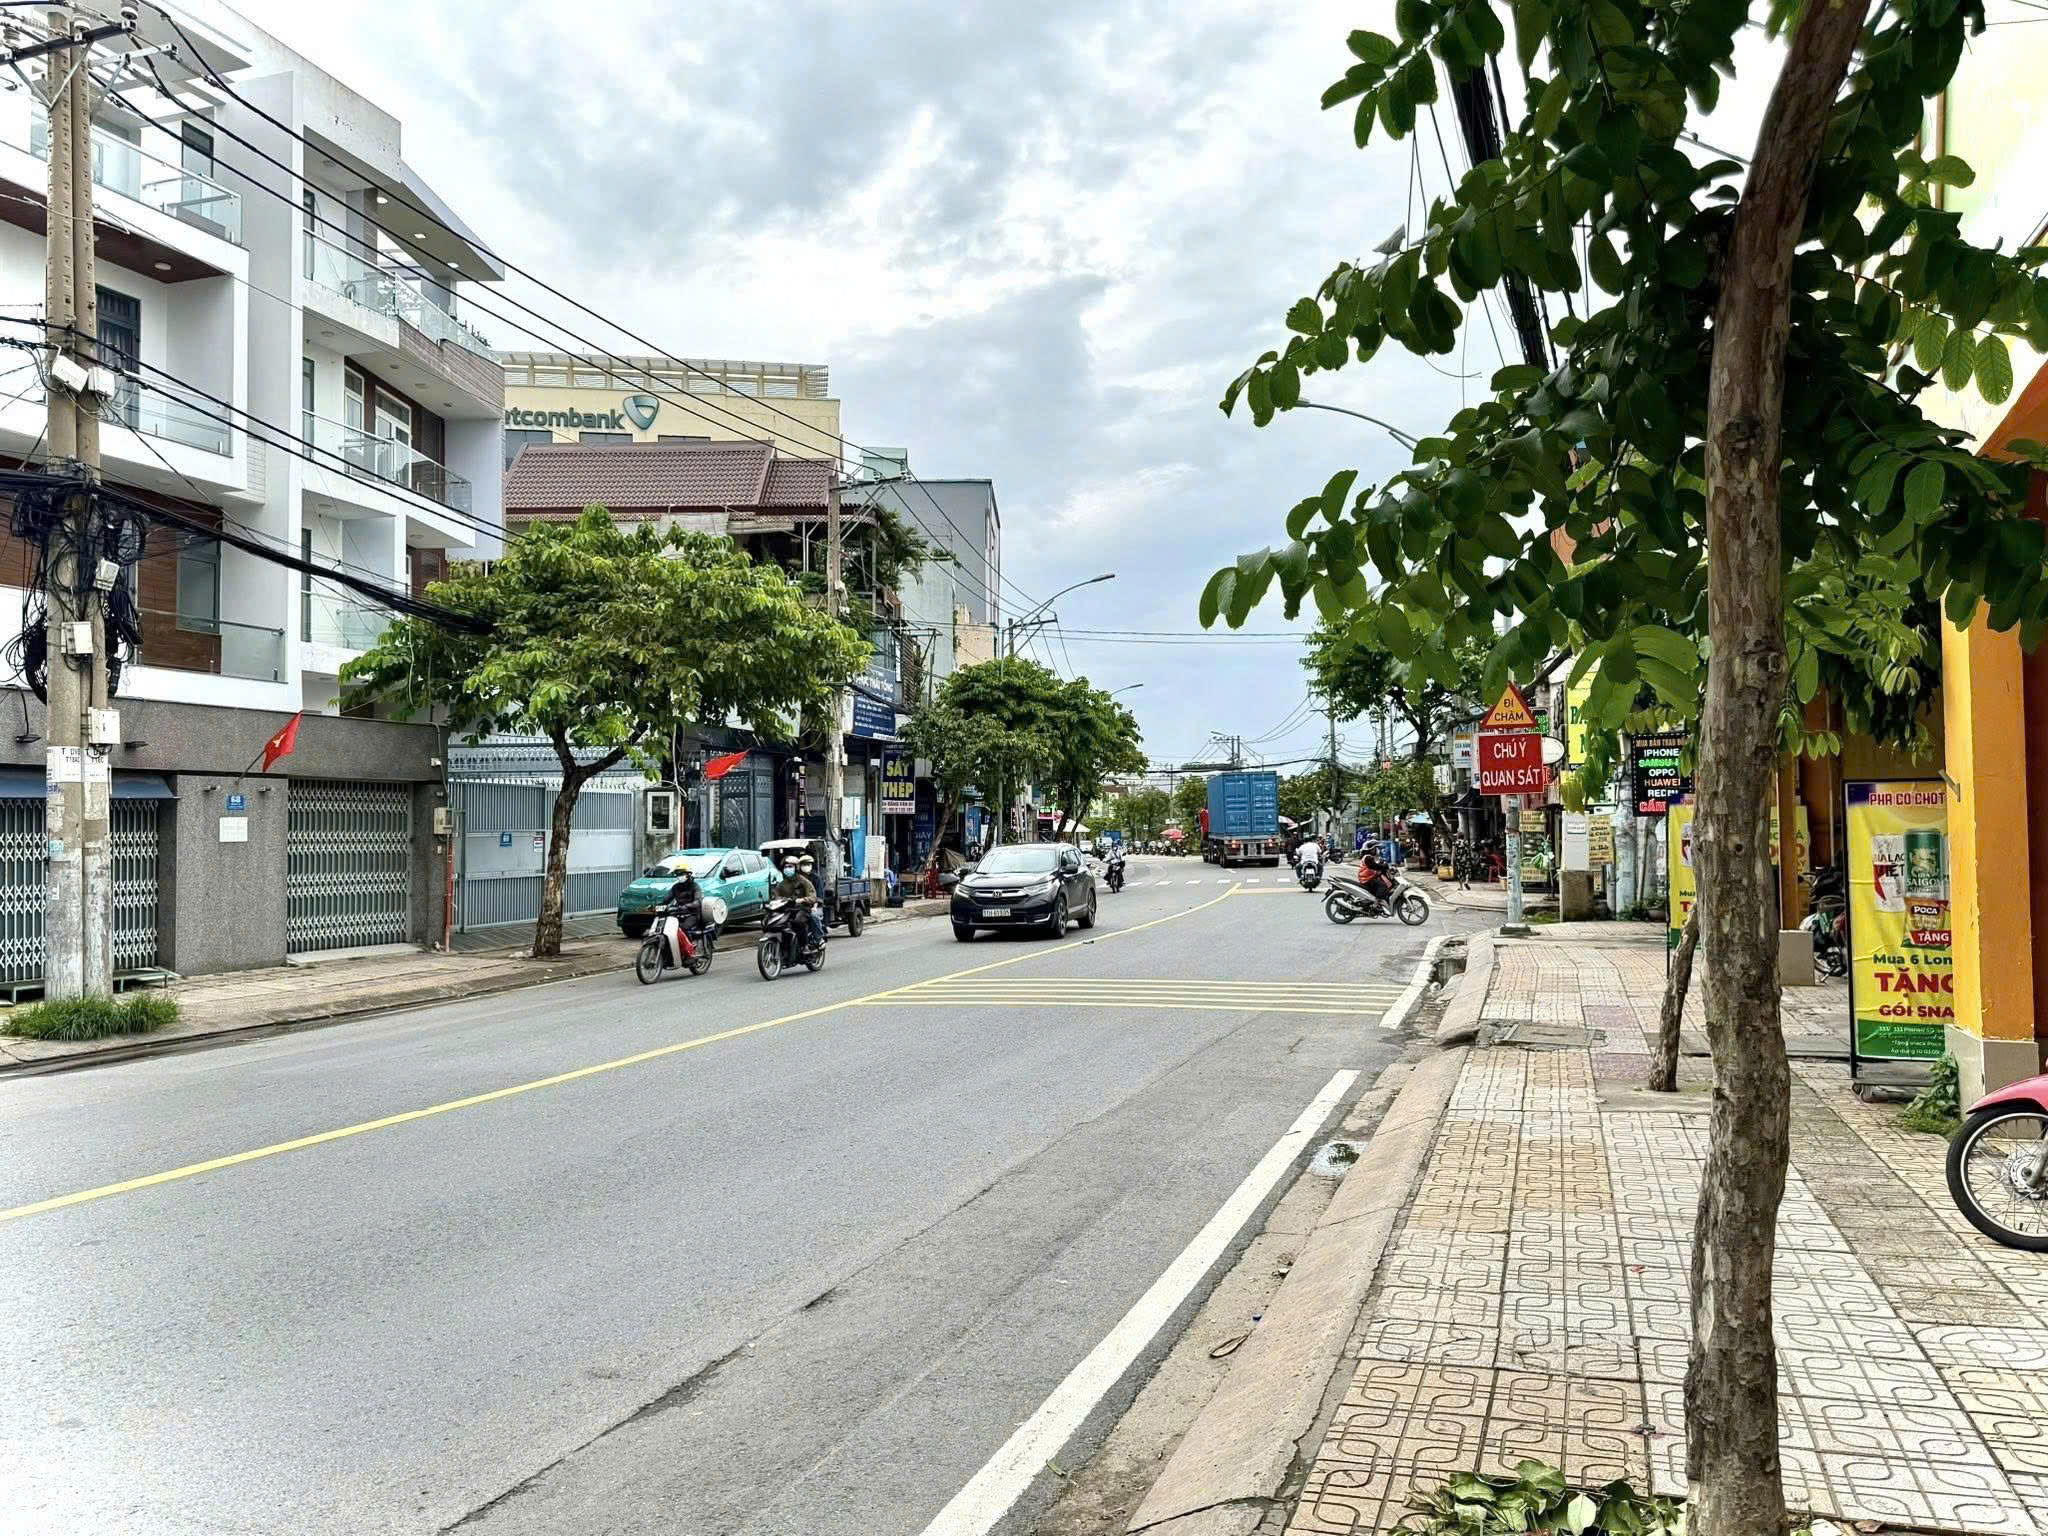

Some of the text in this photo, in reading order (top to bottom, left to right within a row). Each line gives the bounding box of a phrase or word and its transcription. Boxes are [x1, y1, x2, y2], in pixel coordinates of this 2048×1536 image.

[1503, 699, 1514, 708] ĐI
[1494, 709, 1524, 723] CHẬM
[1493, 738, 1527, 759] CHÚ Ý
[1643, 748, 1680, 757] IPHONE
[1482, 770, 1515, 787] QUAN
[1517, 765, 1540, 786] SÁT
[1648, 768, 1676, 777] OPPO
[1644, 778, 1681, 787] HUAWEI
[1913, 905, 1938, 915] POCA
[1873, 953, 1953, 965] Mua 6 Lon
[1879, 1002, 1913, 1018] GÓI
